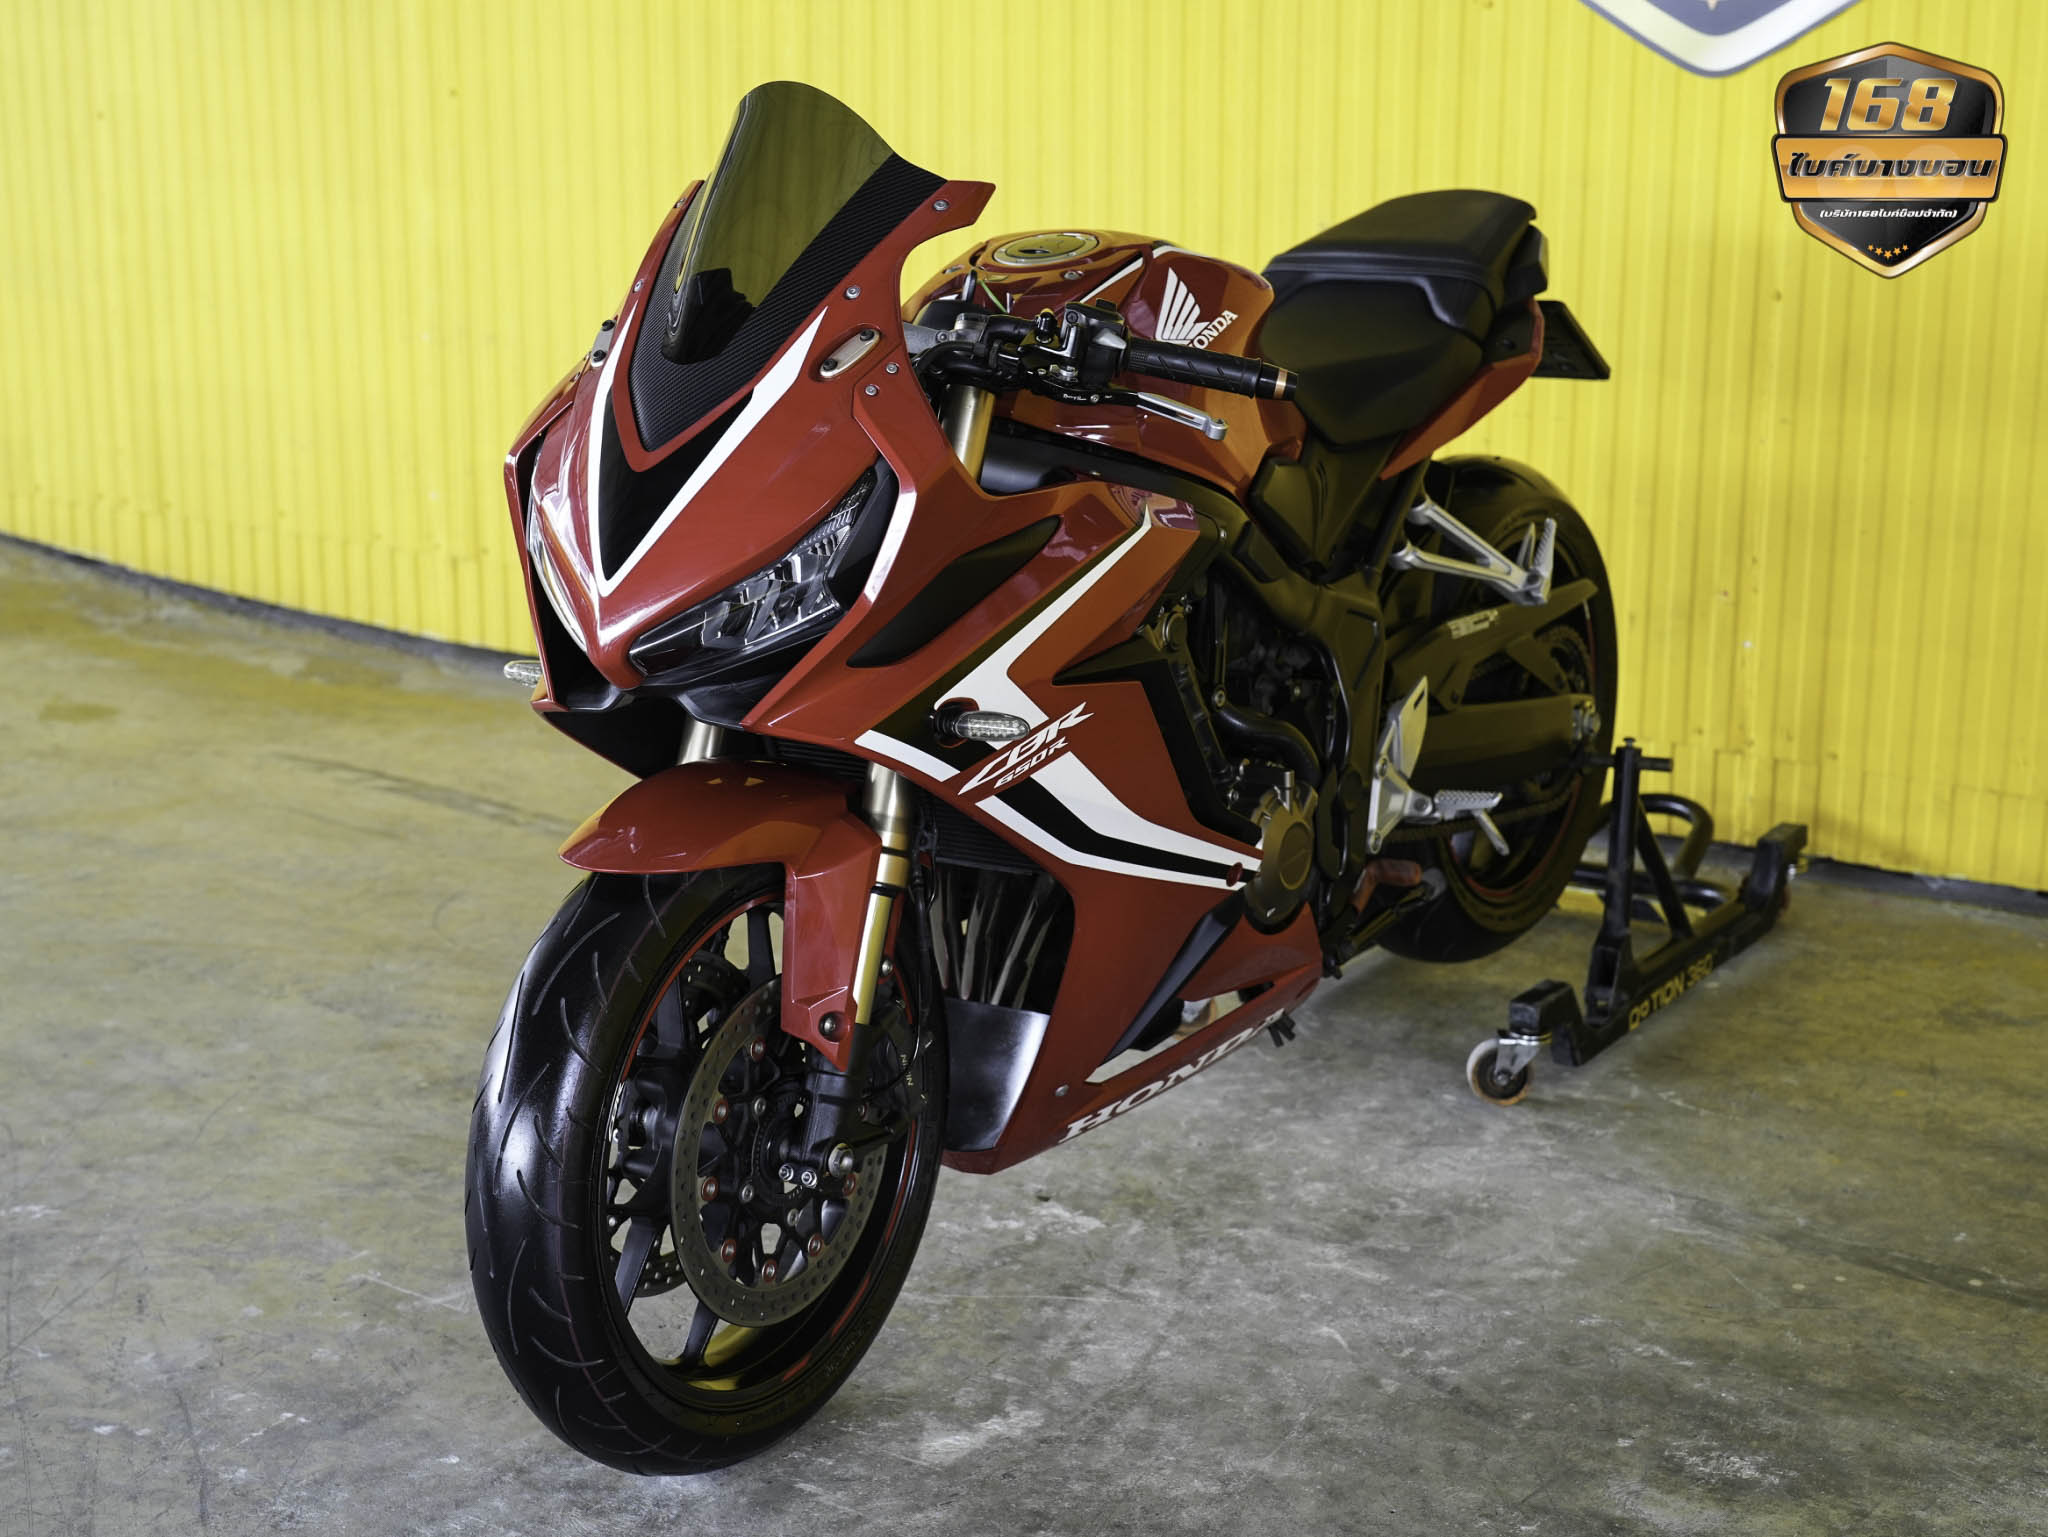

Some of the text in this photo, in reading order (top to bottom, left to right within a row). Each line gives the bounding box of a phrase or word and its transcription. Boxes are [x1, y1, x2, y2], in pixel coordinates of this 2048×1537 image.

[1187, 310, 1239, 350] ONDA
[957, 701, 1095, 796] CBR
[993, 736, 1069, 789] 650R
[1058, 1008, 1284, 1144] HONDA
